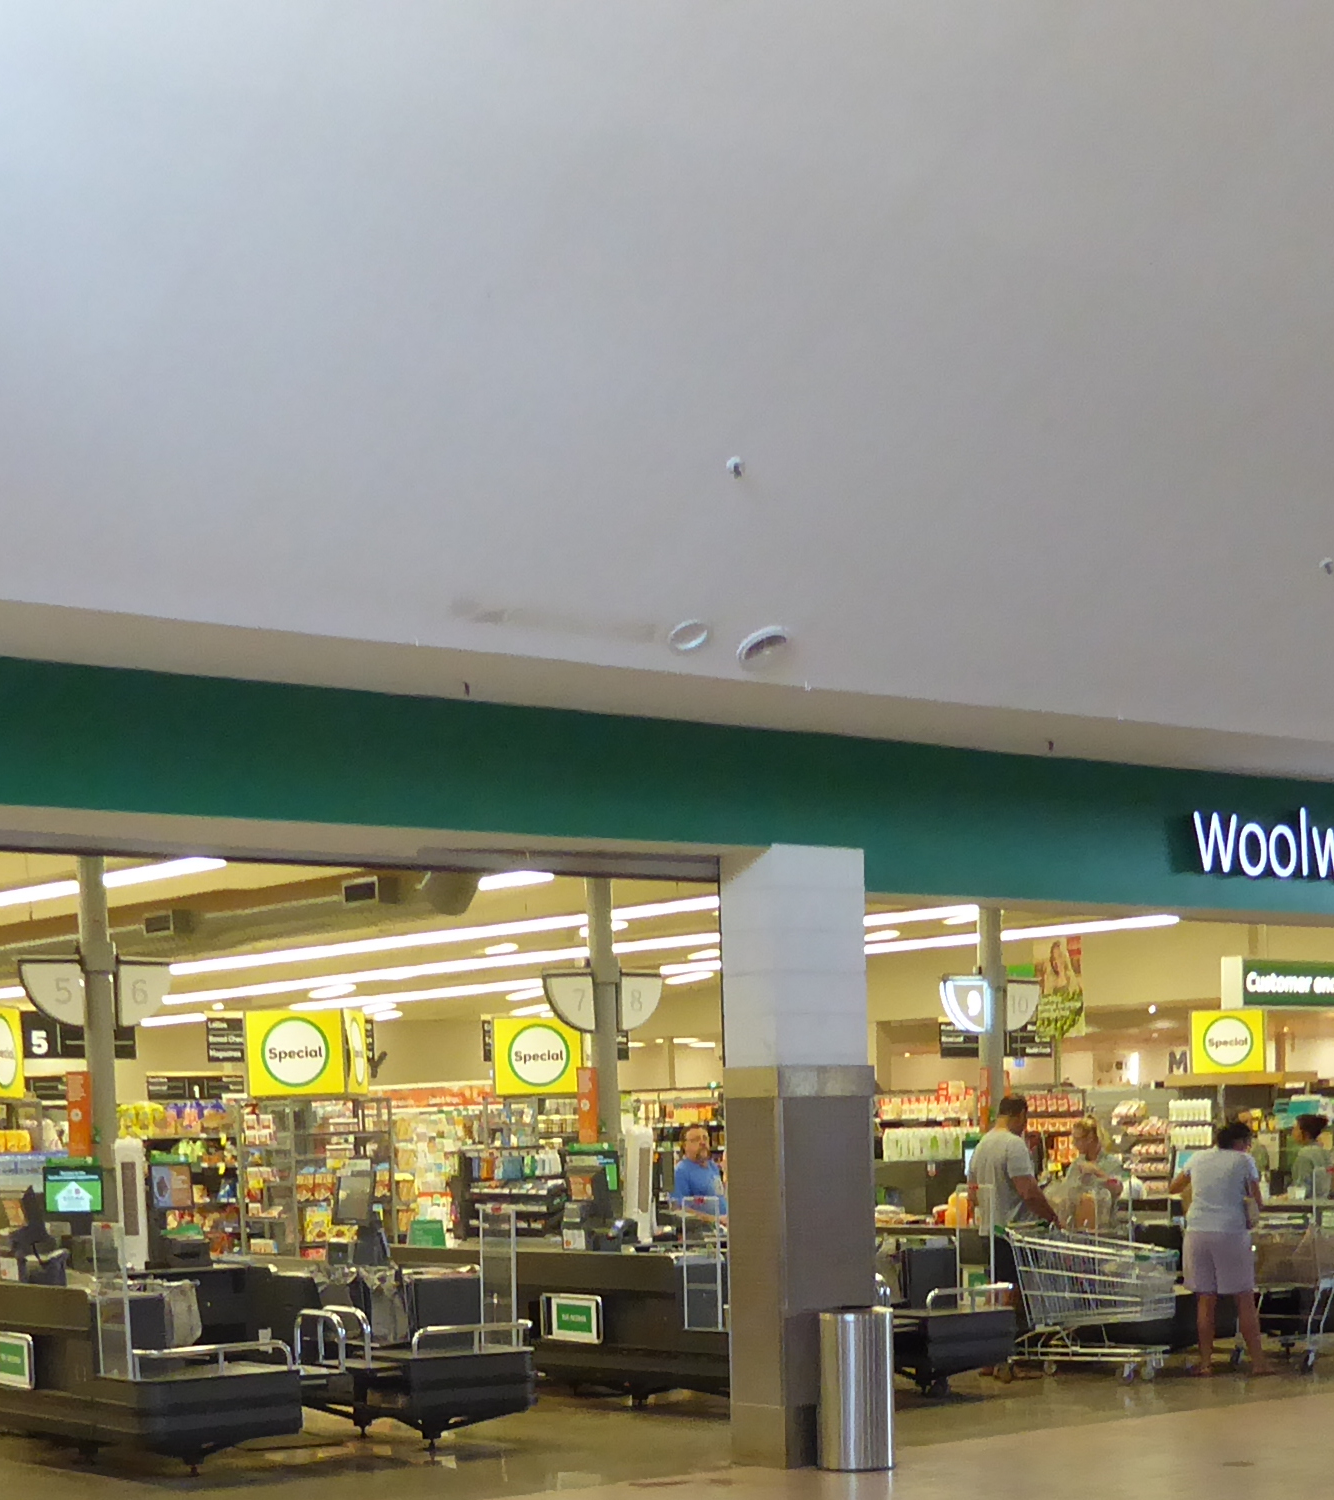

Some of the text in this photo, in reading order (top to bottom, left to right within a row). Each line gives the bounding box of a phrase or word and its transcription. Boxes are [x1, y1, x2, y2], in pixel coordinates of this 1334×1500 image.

[55, 977, 72, 1005] 5
[132, 979, 148, 1005] 6
[1246, 971, 1312, 994] Customer
[572, 988, 585, 1012] 7
[630, 989, 643, 1012] 8
[967, 990, 982, 1017] 9
[1011, 996, 1028, 1014] 10
[31, 1030, 49, 1055] 5
[268, 1045, 323, 1063] Special
[1208, 1037, 1249, 1050] Special
[514, 1050, 564, 1065] Special
